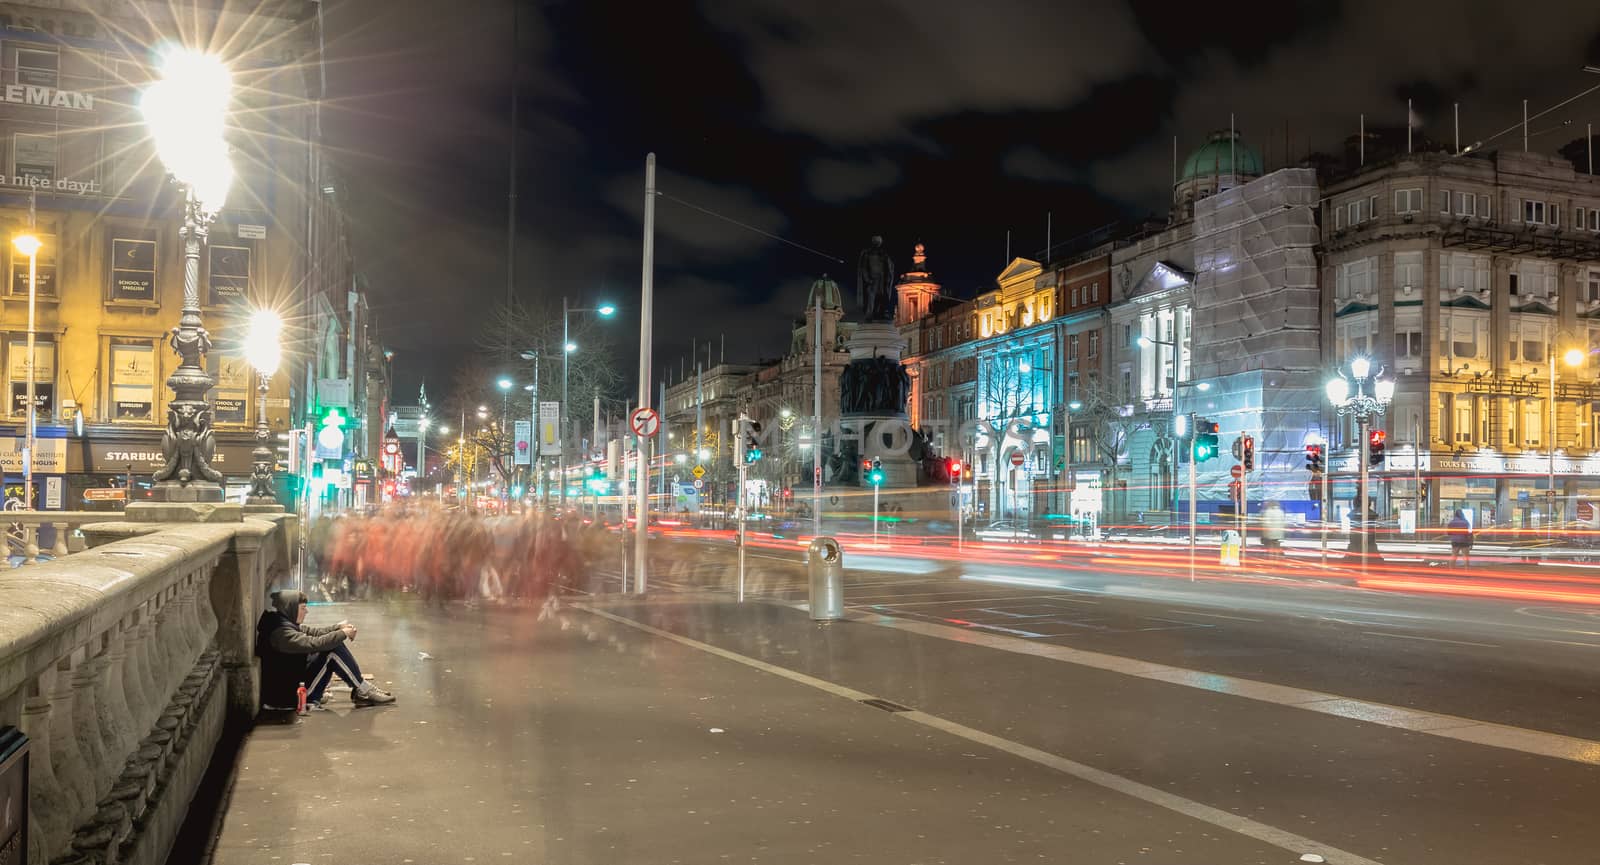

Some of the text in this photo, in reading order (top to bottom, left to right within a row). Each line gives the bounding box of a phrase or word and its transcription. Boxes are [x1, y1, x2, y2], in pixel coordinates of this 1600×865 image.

[13, 173, 50, 188] nice
[57, 177, 94, 195] day!
[1440, 460, 1459, 468] TOURS
